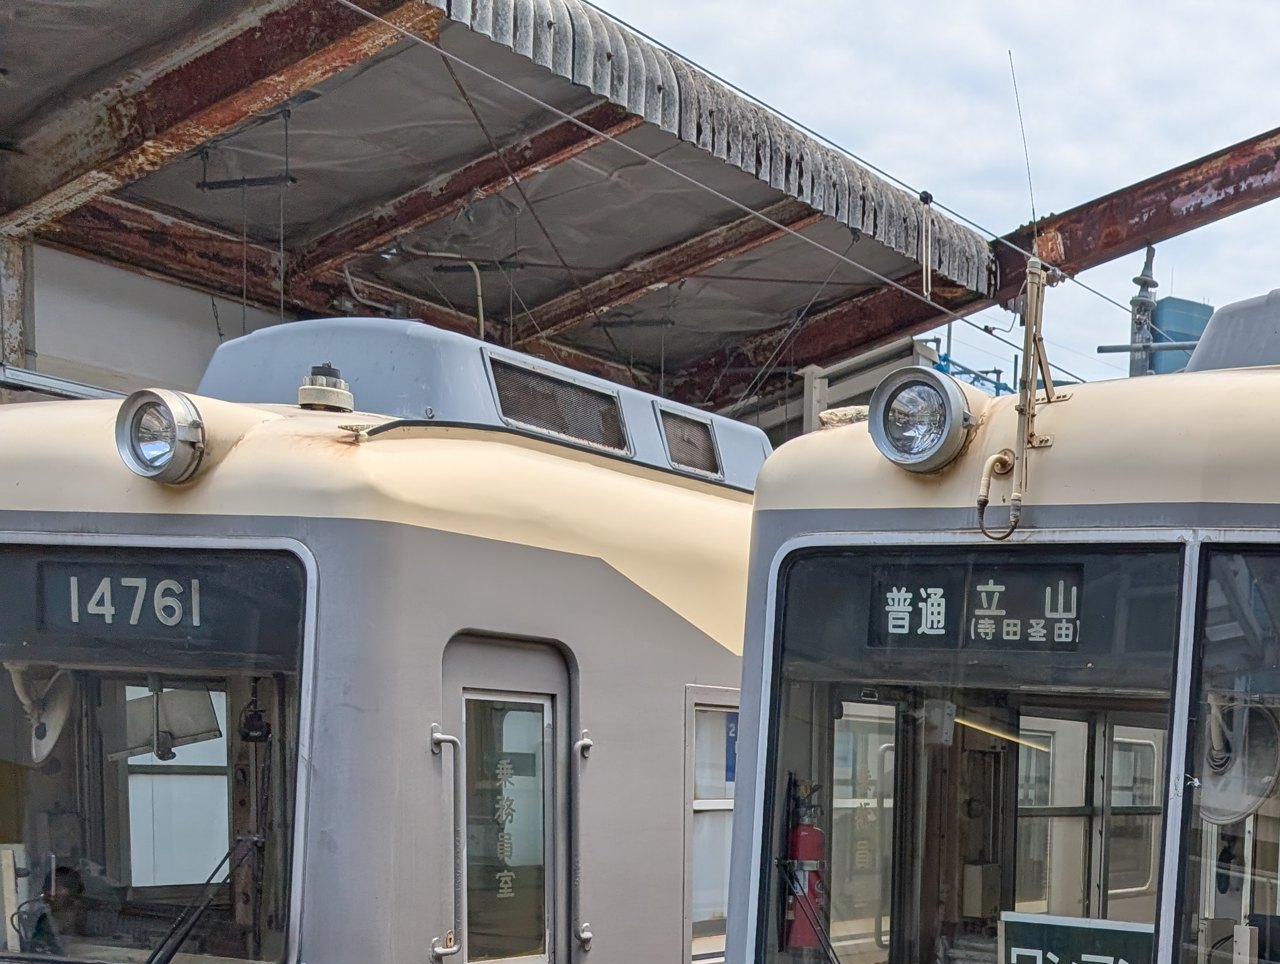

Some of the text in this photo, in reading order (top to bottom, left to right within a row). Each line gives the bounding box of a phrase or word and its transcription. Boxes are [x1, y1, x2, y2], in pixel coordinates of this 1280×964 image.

[70, 576, 200, 627] 14761
[884, 586, 946, 635] 普通
[494, 759, 516, 898] 乗務員室
